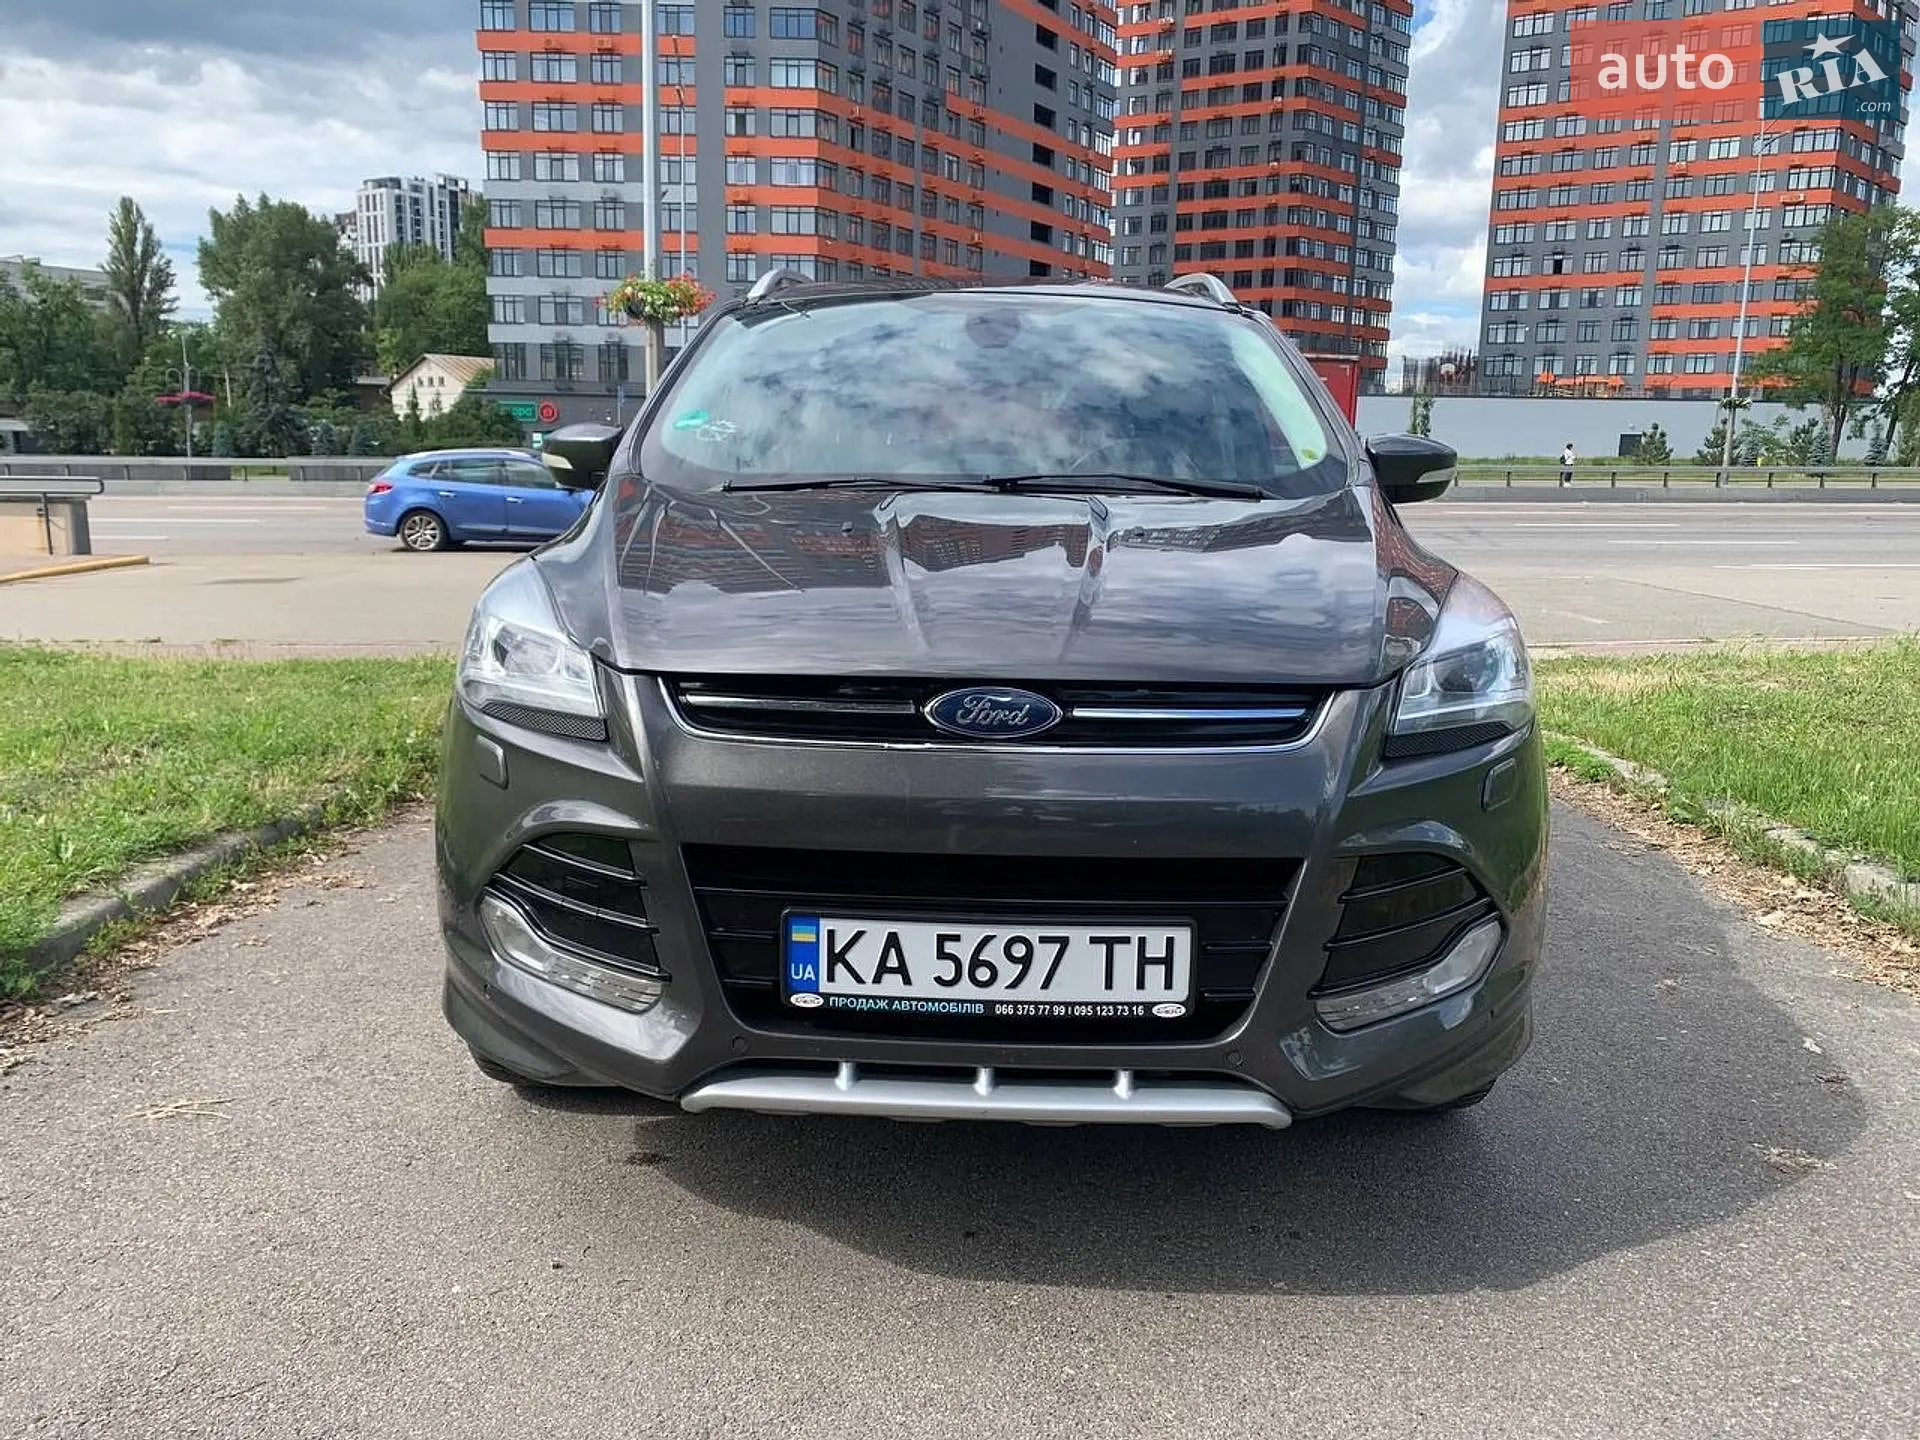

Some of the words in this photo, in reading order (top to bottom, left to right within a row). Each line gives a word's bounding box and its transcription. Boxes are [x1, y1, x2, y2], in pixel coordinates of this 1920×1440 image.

[956, 695, 1030, 725] Ford
[826, 928, 913, 986] KA
[933, 933, 1070, 990] 5697
[1089, 935, 1176, 990] TH
[791, 963, 816, 981] UA
[829, 997, 888, 1010] ПРОДАЖ
[892, 1001, 984, 1014] АВТОМОБІЛІВ
[995, 1004, 1014, 1015] 066
[1017, 1004, 1034, 1016] 375
[1037, 1005, 1050, 1016] 77
[1052, 1005, 1065, 1016] 99
[1074, 1005, 1093, 1016] 095
[1096, 1005, 1114, 1016] 123
[1117, 1005, 1129, 1016] 73
[1132, 1006, 1145, 1016] 16
